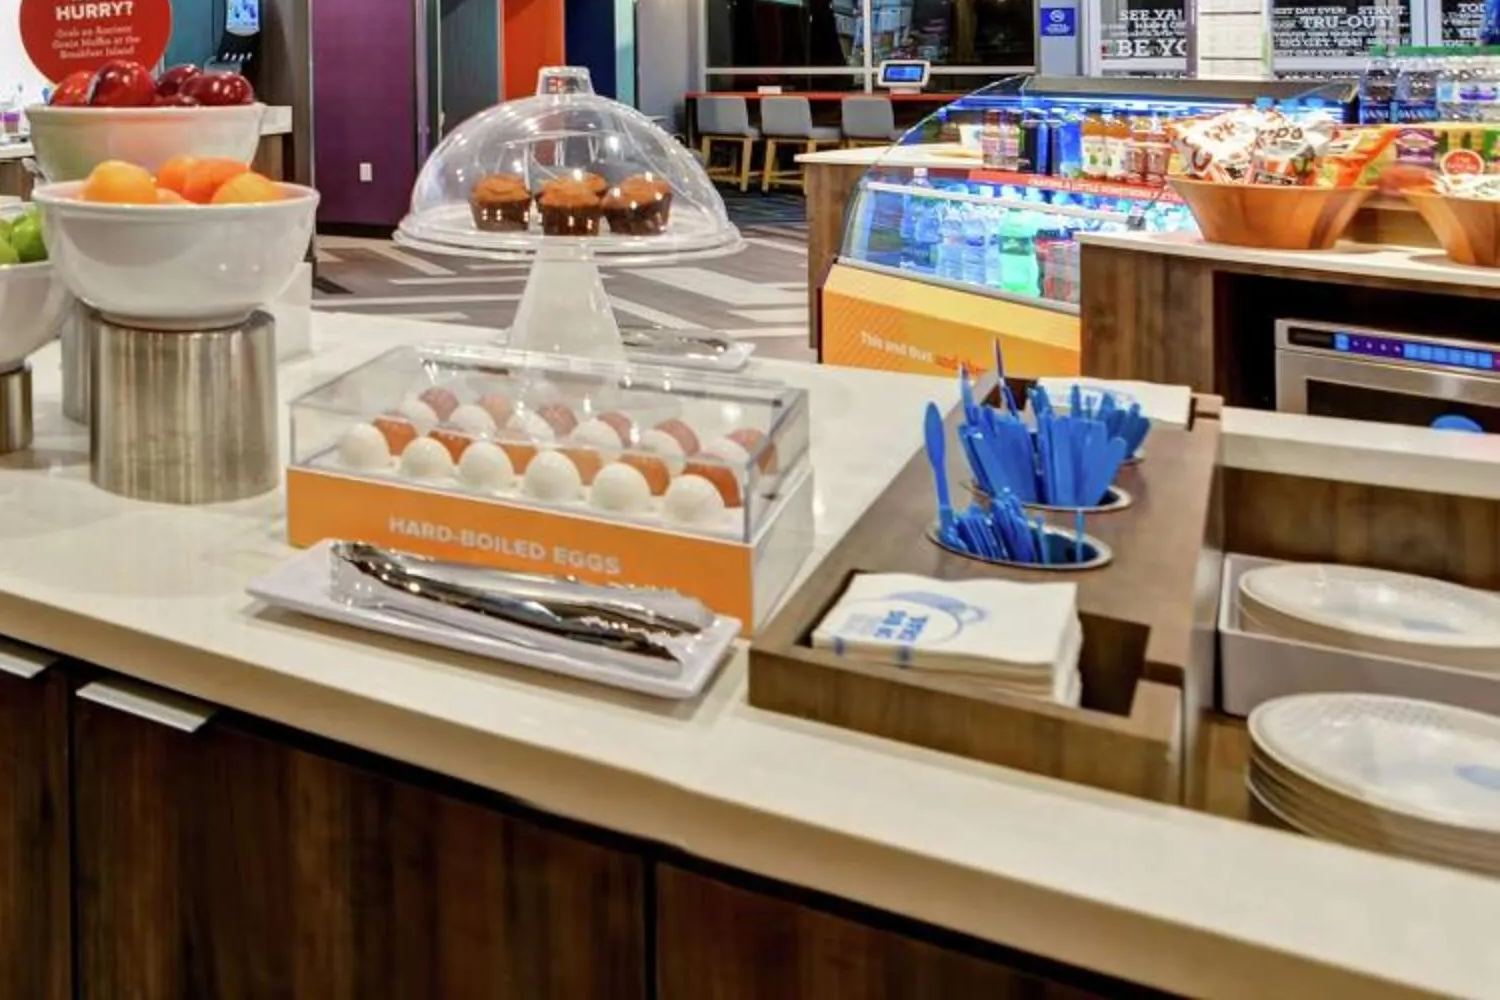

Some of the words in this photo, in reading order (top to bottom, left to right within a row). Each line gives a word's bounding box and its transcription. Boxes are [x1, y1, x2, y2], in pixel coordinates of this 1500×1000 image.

[55, 1, 134, 21] HURRY?
[1120, 9, 1152, 21] SEE
[1155, 8, 1183, 21] YA!
[1116, 39, 1151, 56] BE
[389, 517, 546, 560] HARD-BOILED
[553, 546, 621, 574] EGGS
